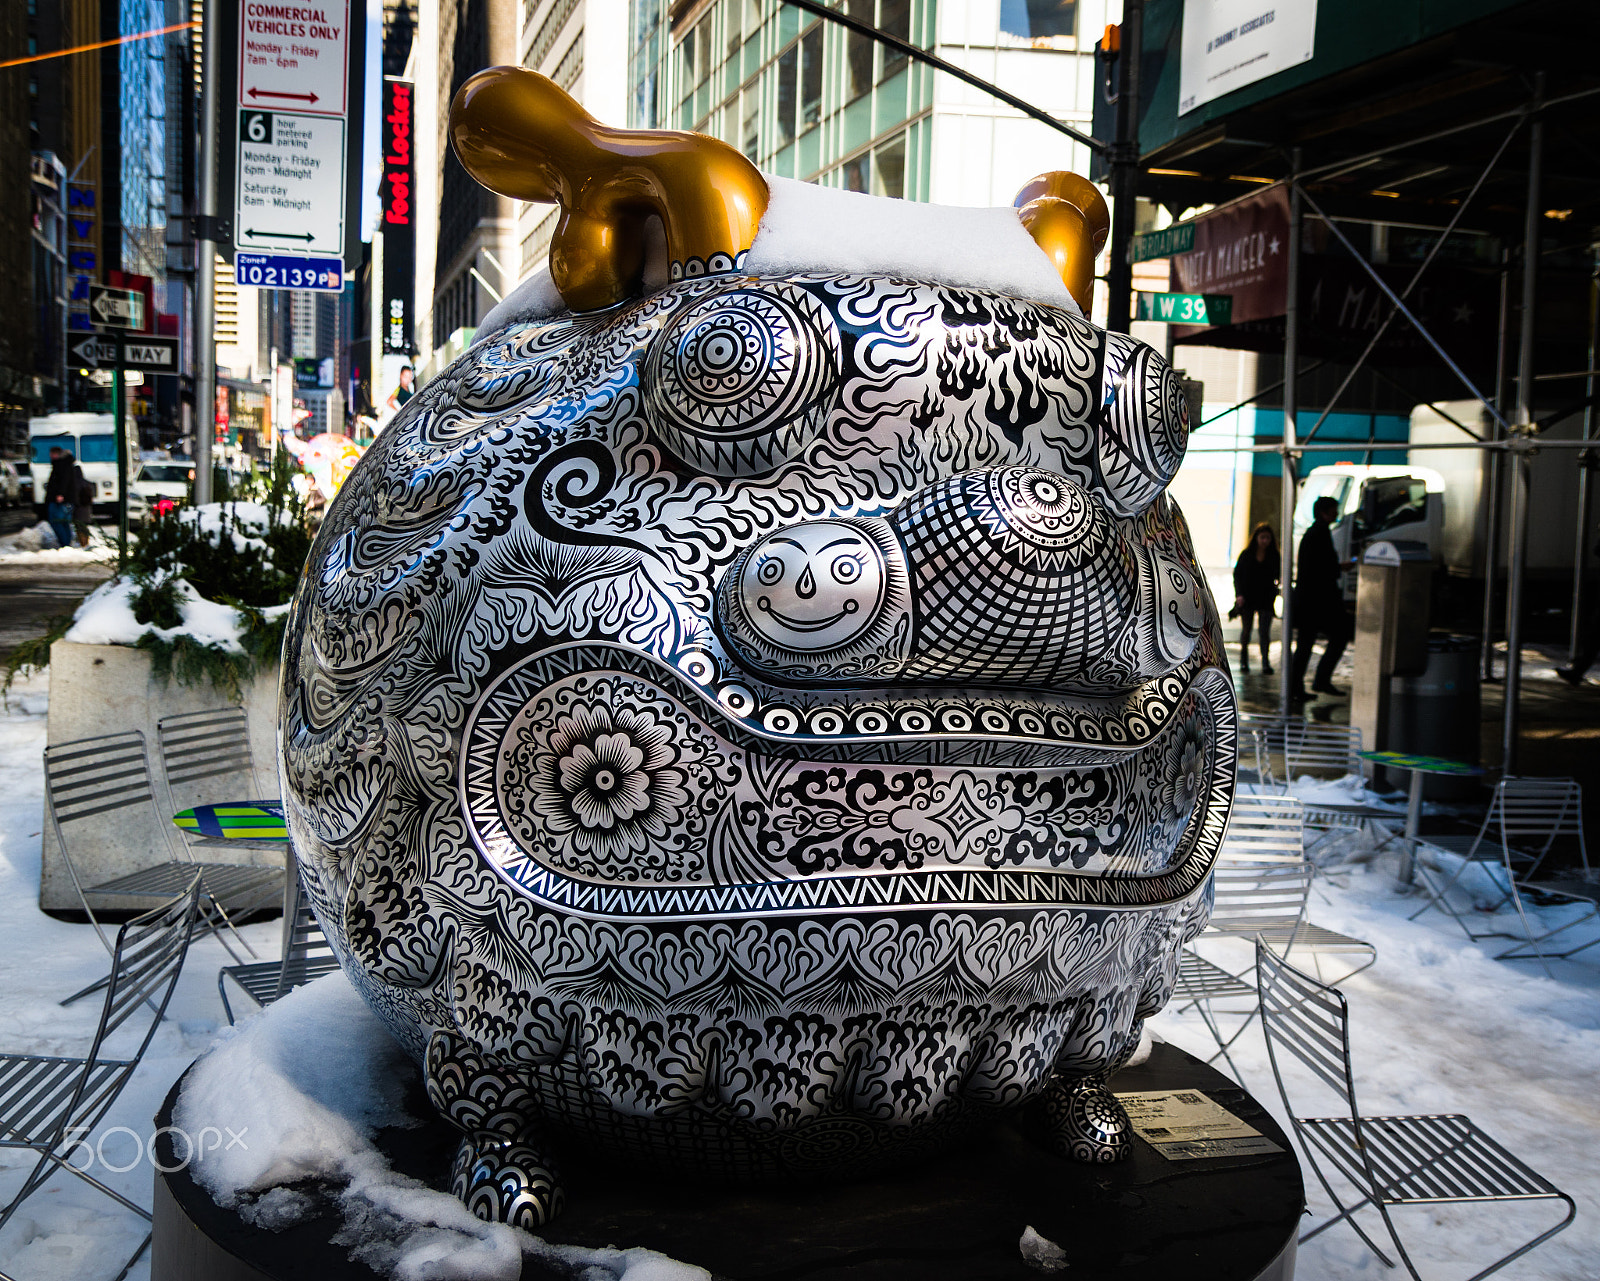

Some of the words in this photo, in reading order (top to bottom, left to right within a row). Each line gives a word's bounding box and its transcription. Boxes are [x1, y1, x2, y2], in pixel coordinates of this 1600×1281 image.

[248, 4, 328, 24] COMMERCIAL
[248, 20, 306, 37] VEHICLES
[309, 25, 341, 40] ONLY
[246, 40, 283, 55] Monday
[291, 44, 320, 59] Friday
[247, 54, 267, 65] 7am
[276, 58, 299, 69] 6pm
[248, 114, 266, 142] 6
[277, 119, 297, 129] hour
[386, 83, 410, 166] Locker
[277, 129, 313, 140] metered
[277, 139, 309, 149] parking
[244, 151, 282, 164] Monday
[291, 154, 321, 168] Friday
[244, 164, 266, 176] 6pm
[273, 166, 312, 180] Midnight
[244, 182, 288, 196] Saturday
[243, 195, 265, 207] 8am
[273, 197, 311, 211] Midnight
[386, 172, 410, 225] Foot
[1141, 226, 1193, 260] BROADWAY
[1216, 231, 1266, 279] MANGER
[100, 299, 118, 315] ONE
[1159, 297, 1175, 318] W
[1180, 297, 1207, 320] 39
[82, 342, 117, 360] ONE
[130, 346, 166, 360] WAY
